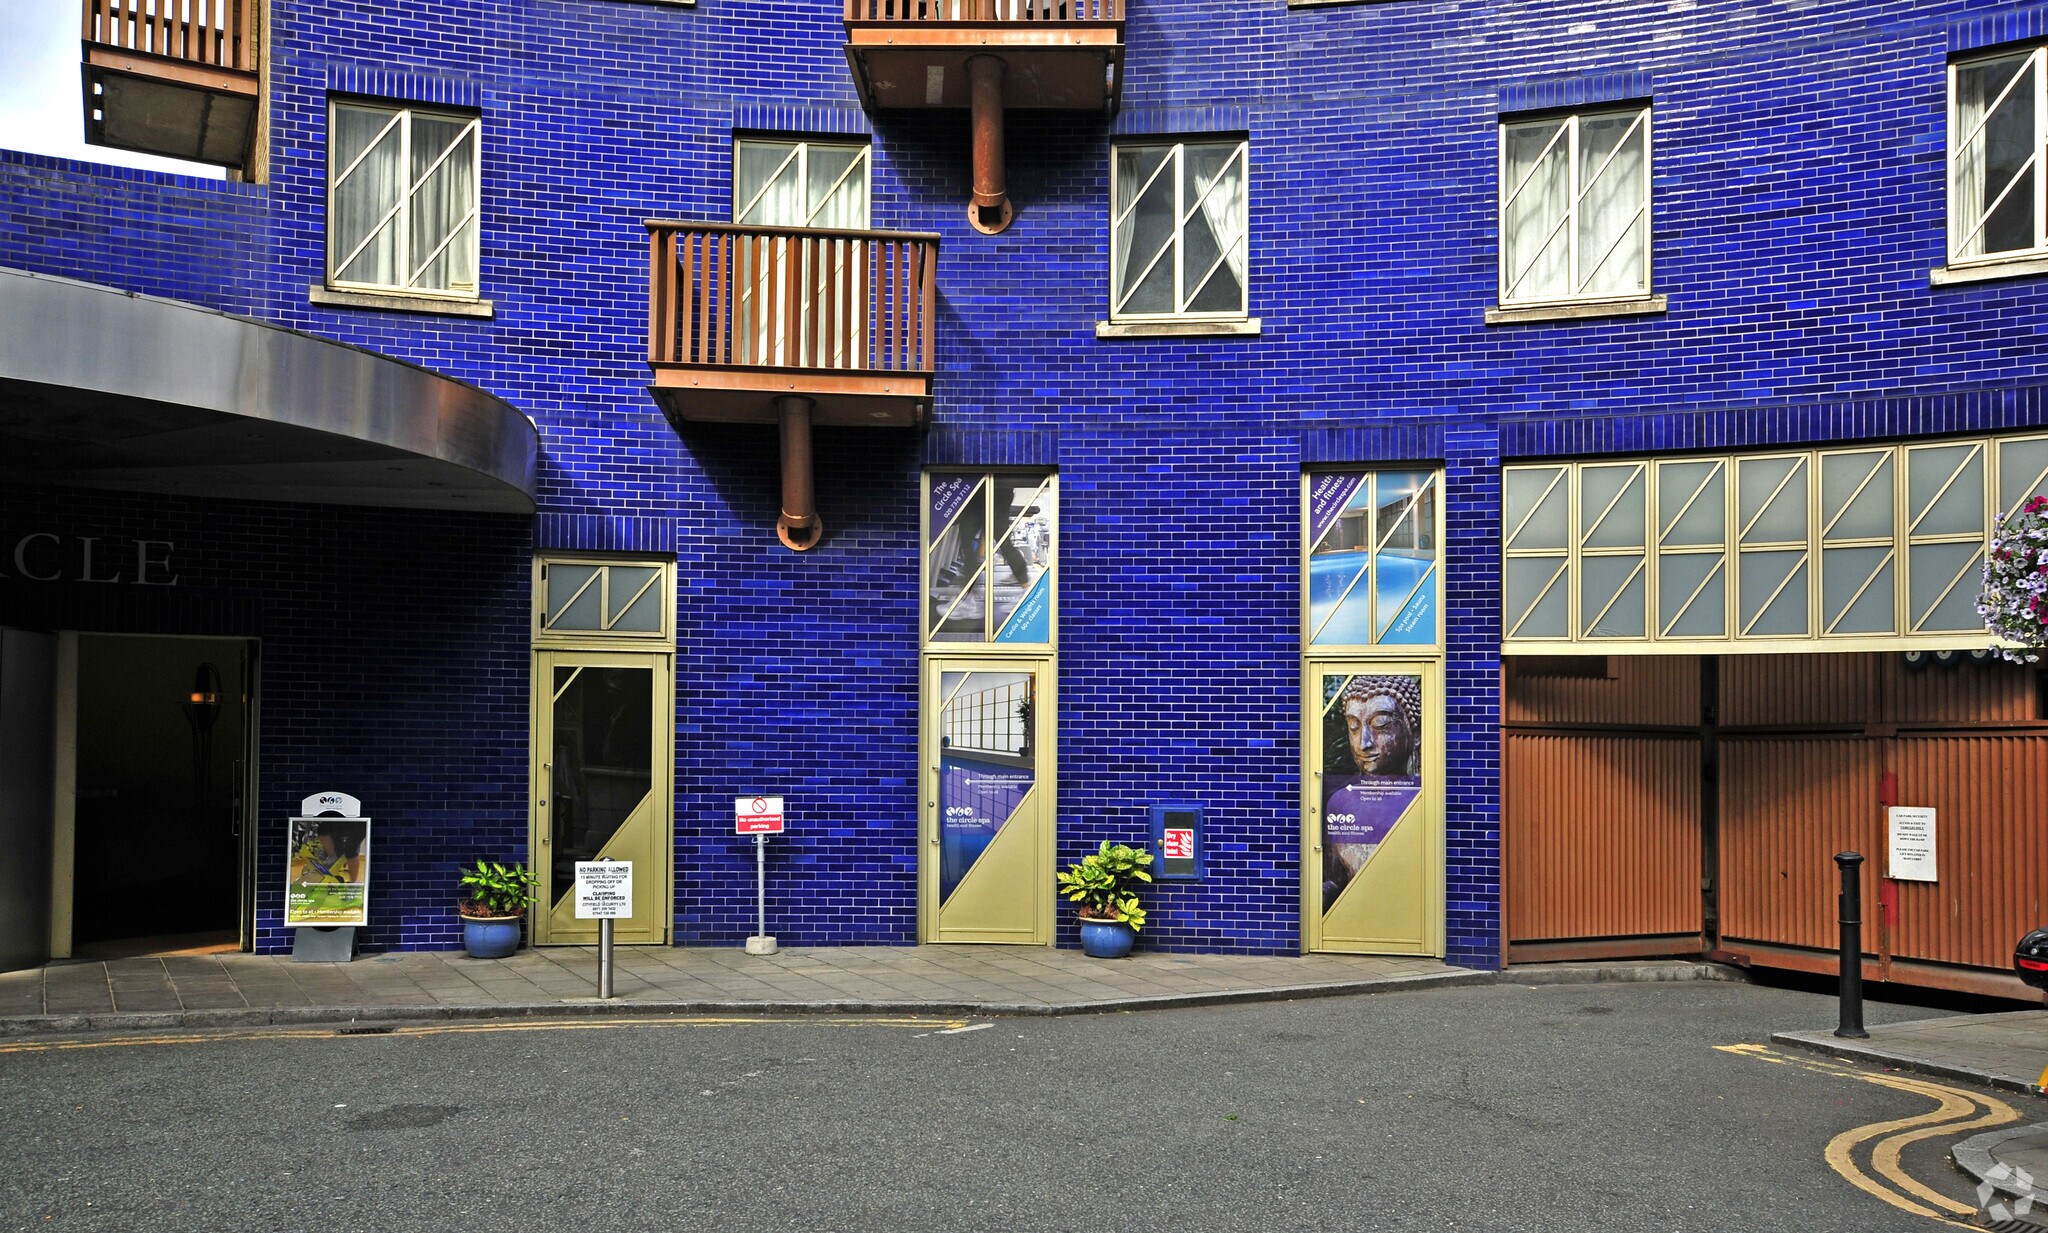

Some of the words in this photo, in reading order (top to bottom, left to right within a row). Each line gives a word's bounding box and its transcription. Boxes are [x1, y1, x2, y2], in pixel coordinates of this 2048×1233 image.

[934, 482, 947, 494] The
[934, 491, 952, 511] Circle
[950, 478, 962, 491] Spa
[944, 508, 953, 518] 020
[951, 496, 962, 509] 7378
[960, 484, 971, 496] 7112
[1312, 475, 1334, 500] Health
[1314, 499, 1327, 514] and
[1323, 476, 1345, 500] fitness
[1317, 478, 1356, 528] www.thecirclespa.com
[1006, 623, 1019, 638] Cardio
[1020, 600, 1036, 619] Weights
[1035, 587, 1045, 600] room
[1021, 621, 1030, 631] 60+
[1028, 604, 1042, 621] classes
[1396, 623, 1404, 632] Spa
[1403, 611, 1413, 624] pool
[1412, 594, 1425, 610] Sauna
[1405, 617, 1419, 632] Steam
[1417, 604, 1429, 617] room
